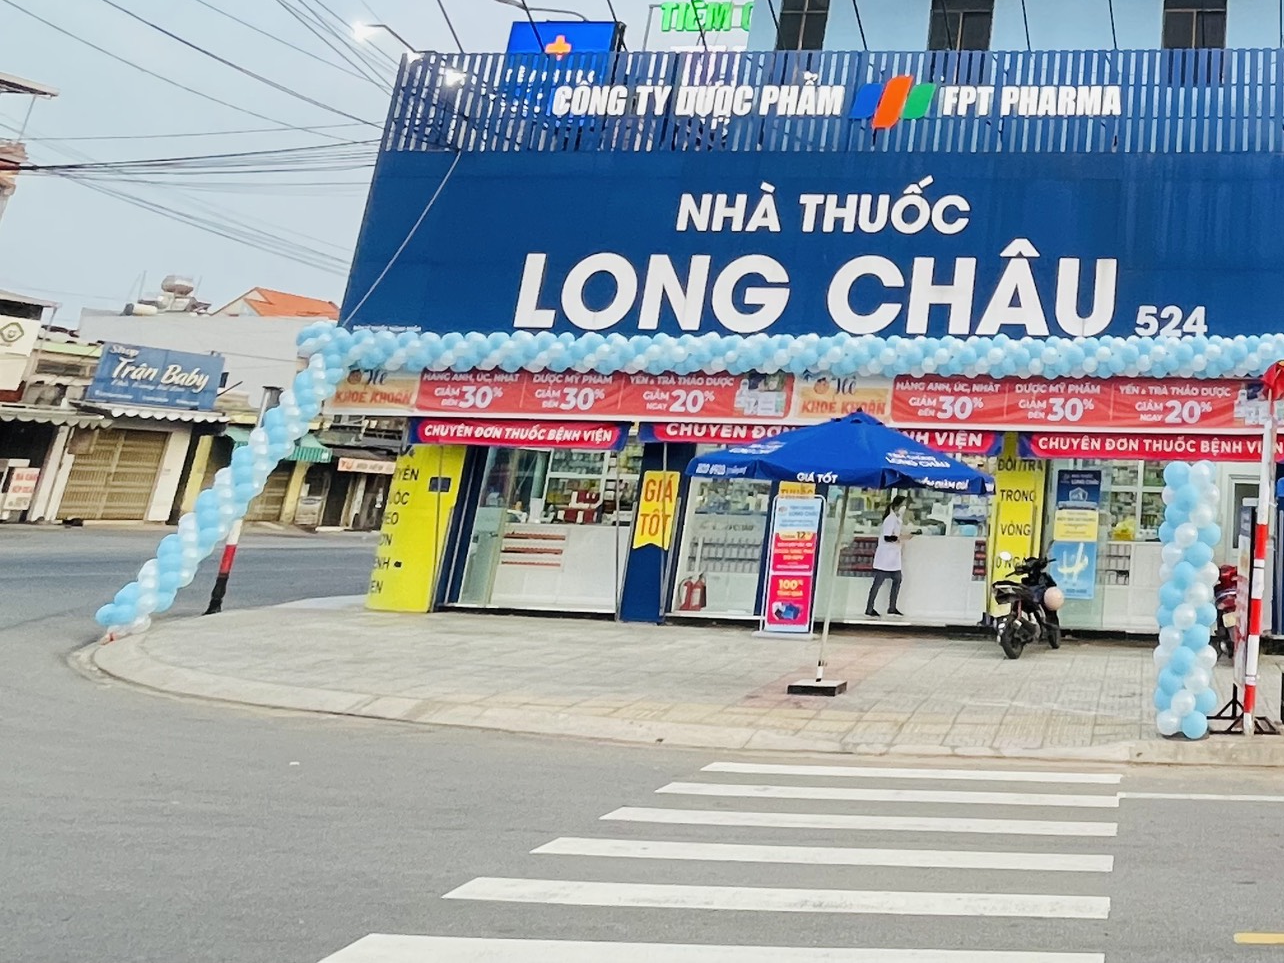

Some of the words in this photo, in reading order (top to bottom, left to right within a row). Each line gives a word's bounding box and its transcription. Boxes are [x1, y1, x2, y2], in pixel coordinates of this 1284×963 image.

[551, 79, 628, 116] CÔNG
[758, 71, 846, 116] PHẨM
[942, 85, 995, 116] FPT
[1001, 85, 1122, 116] PHARMA
[675, 181, 781, 232] NHÀ
[799, 174, 971, 235] THUỐC
[513, 251, 790, 334] LONG
[826, 237, 1119, 337] CHÂU
[1134, 305, 1208, 336] 524
[112, 357, 159, 381] Trân
[160, 364, 210, 394] Baby
[1139, 413, 1163, 422] NGAY
[424, 421, 474, 439] CHUYÊN
[474, 424, 503, 439] ĐƠN
[504, 423, 546, 441] THUỐC
[546, 425, 581, 444] BỆNH
[582, 427, 613, 445] VIỆN
[935, 431, 983, 450] VIỆN
[1038, 435, 1101, 451] CHUYÊN
[1105, 437, 1139, 452] ĐƠN
[1142, 435, 1197, 453] THUỐC
[1200, 437, 1243, 456] BỆNH
[1246, 439, 1284, 455] VIN
[644, 473, 674, 503] GIÁ
[797, 471, 816, 483] GIÁ
[816, 471, 839, 484] TỐT
[1000, 521, 1031, 536] VÒNG
